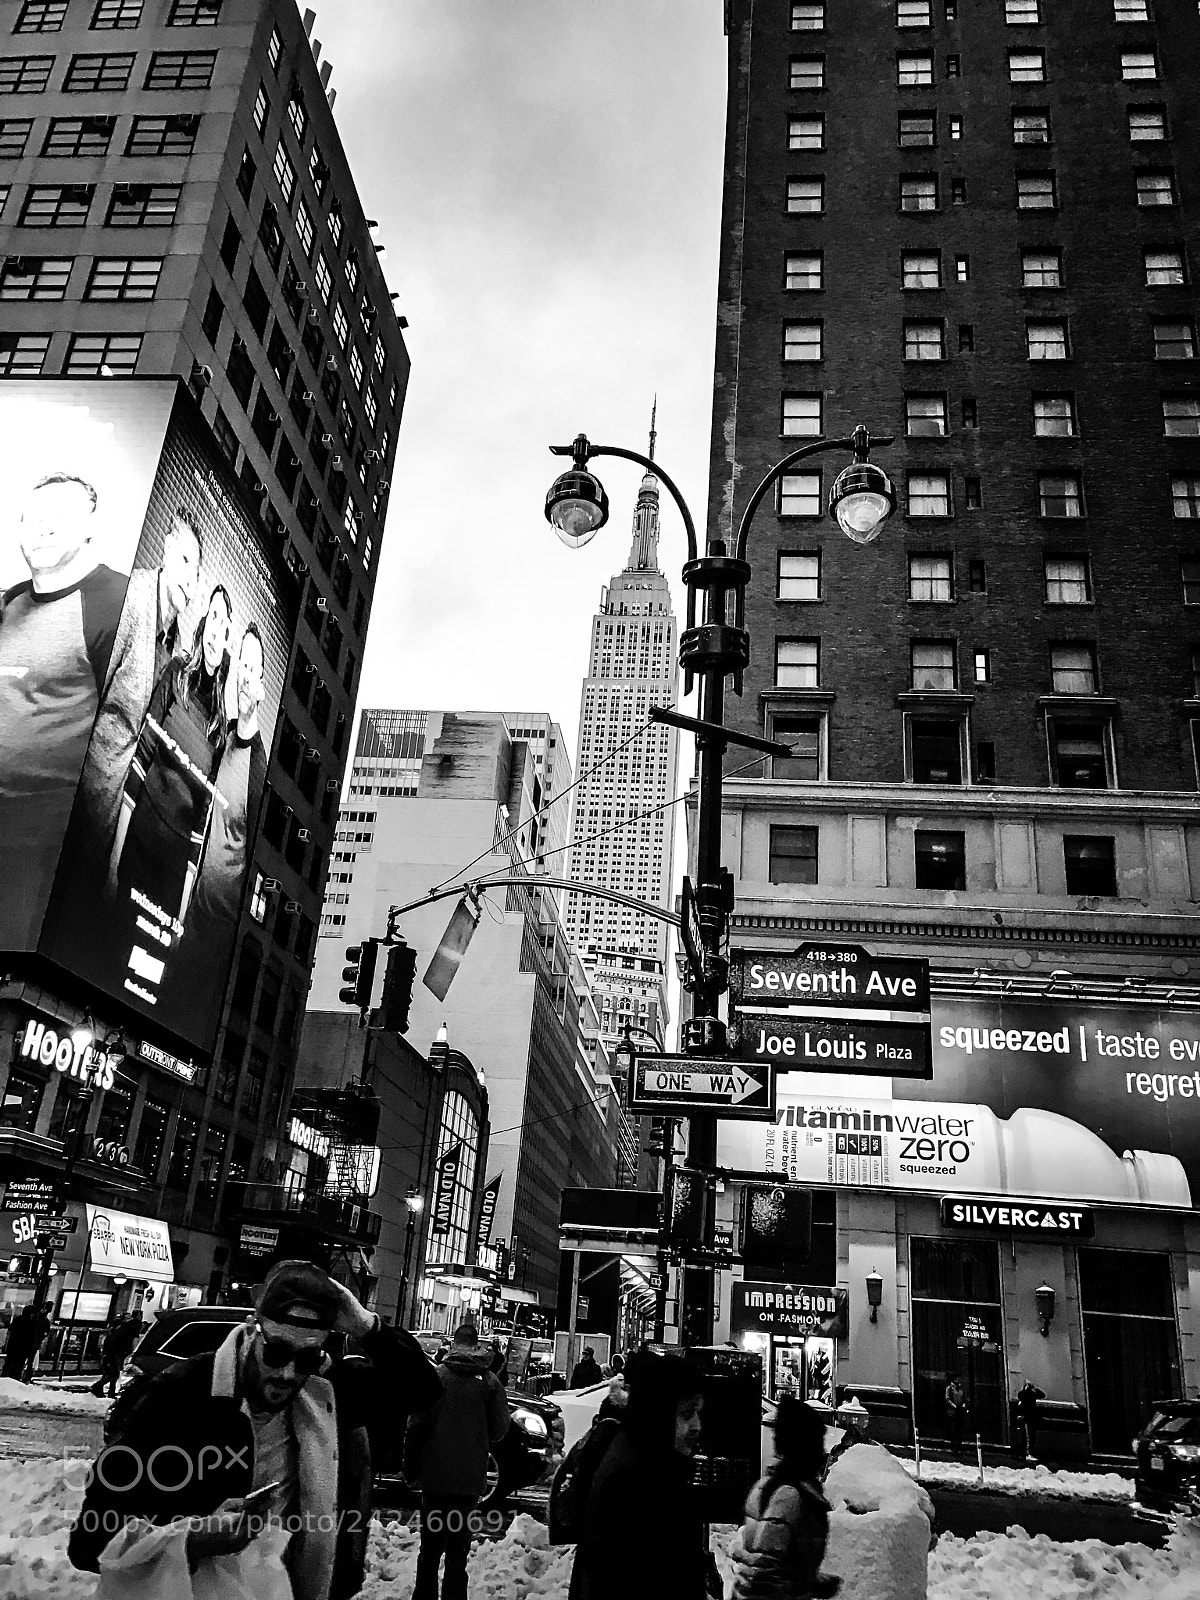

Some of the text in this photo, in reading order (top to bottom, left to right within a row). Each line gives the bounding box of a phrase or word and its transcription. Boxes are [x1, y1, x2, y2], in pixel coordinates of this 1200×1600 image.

[750, 964, 917, 997] Seventh Ave
[756, 1029, 913, 1060] Joe Louis Plaza
[939, 1026, 1070, 1055] squeezed
[1095, 1029, 1160, 1059] taste
[1169, 1038, 1200, 1061] ev
[141, 1042, 175, 1070] OUTFRONT
[656, 1073, 749, 1094] ONE WAY
[782, 1130, 790, 1153] water
[790, 1130, 798, 1163] nutrient
[899, 1137, 970, 1163] zero
[899, 1164, 956, 1175] squeezed
[9, 1181, 53, 1192] Seventh Ave
[436, 1162, 456, 1231] OLD NAVY
[5, 1200, 48, 1210] Fashion Ave
[477, 1190, 496, 1245] OLD NAVY
[93, 1228, 116, 1243] SBARRO
[714, 1234, 730, 1244] Ave
[120, 1236, 170, 1262] NEW YORK PIZZA
[744, 1291, 836, 1313] IMPRESSION
[759, 1312, 774, 1322] ON
